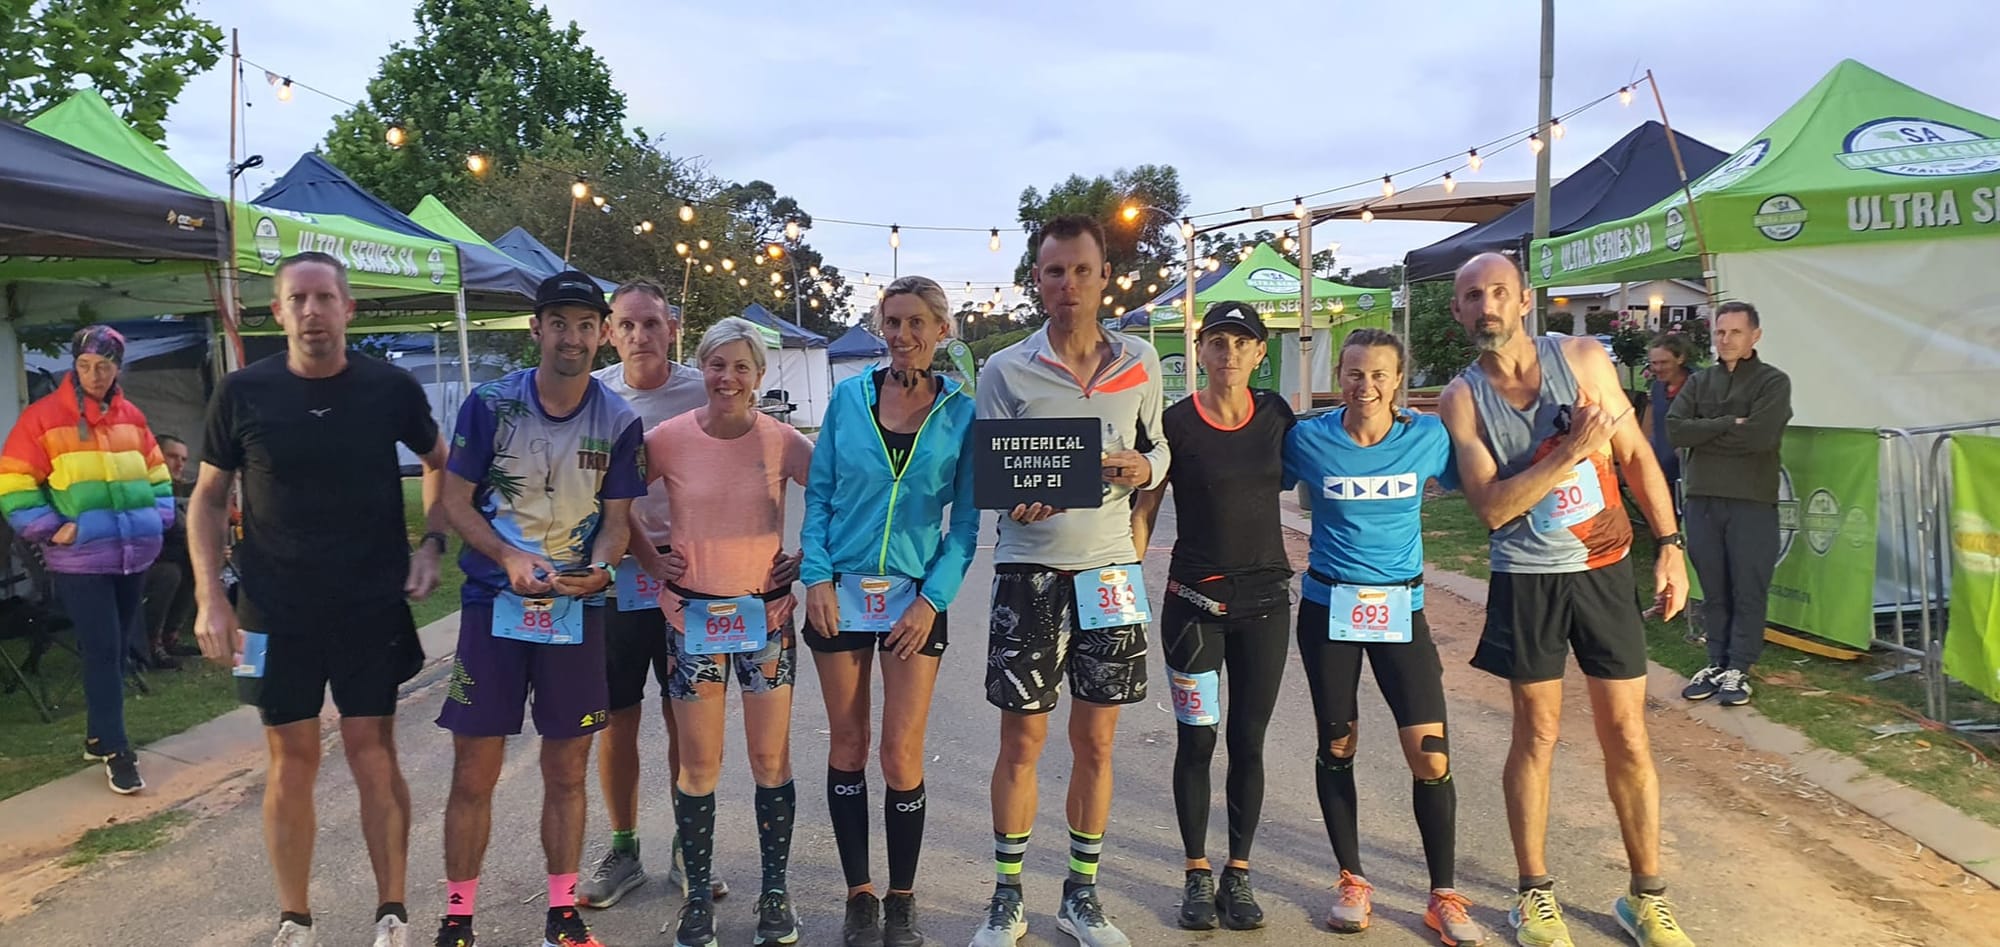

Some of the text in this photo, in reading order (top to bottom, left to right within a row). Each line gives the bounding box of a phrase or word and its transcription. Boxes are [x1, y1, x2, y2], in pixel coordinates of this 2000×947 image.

[1899, 127, 1945, 143] SA
[1846, 149, 1926, 166] ULTRA
[1847, 189, 1961, 231] ULTRA
[1560, 238, 1593, 272] ULTRA
[1592, 226, 1634, 264] SERIES
[1634, 221, 1652, 255] SA
[351, 240, 400, 275] SERIES
[400, 248, 420, 277] SA
[1004, 455, 1071, 469] CARNAGE
[1013, 474, 1062, 488] LAP 21
[1553, 485, 1582, 510] 30
[864, 594, 887, 613] 13
[523, 611, 552, 628] 88
[1351, 604, 1389, 625] 693
[705, 615, 746, 635] 694
